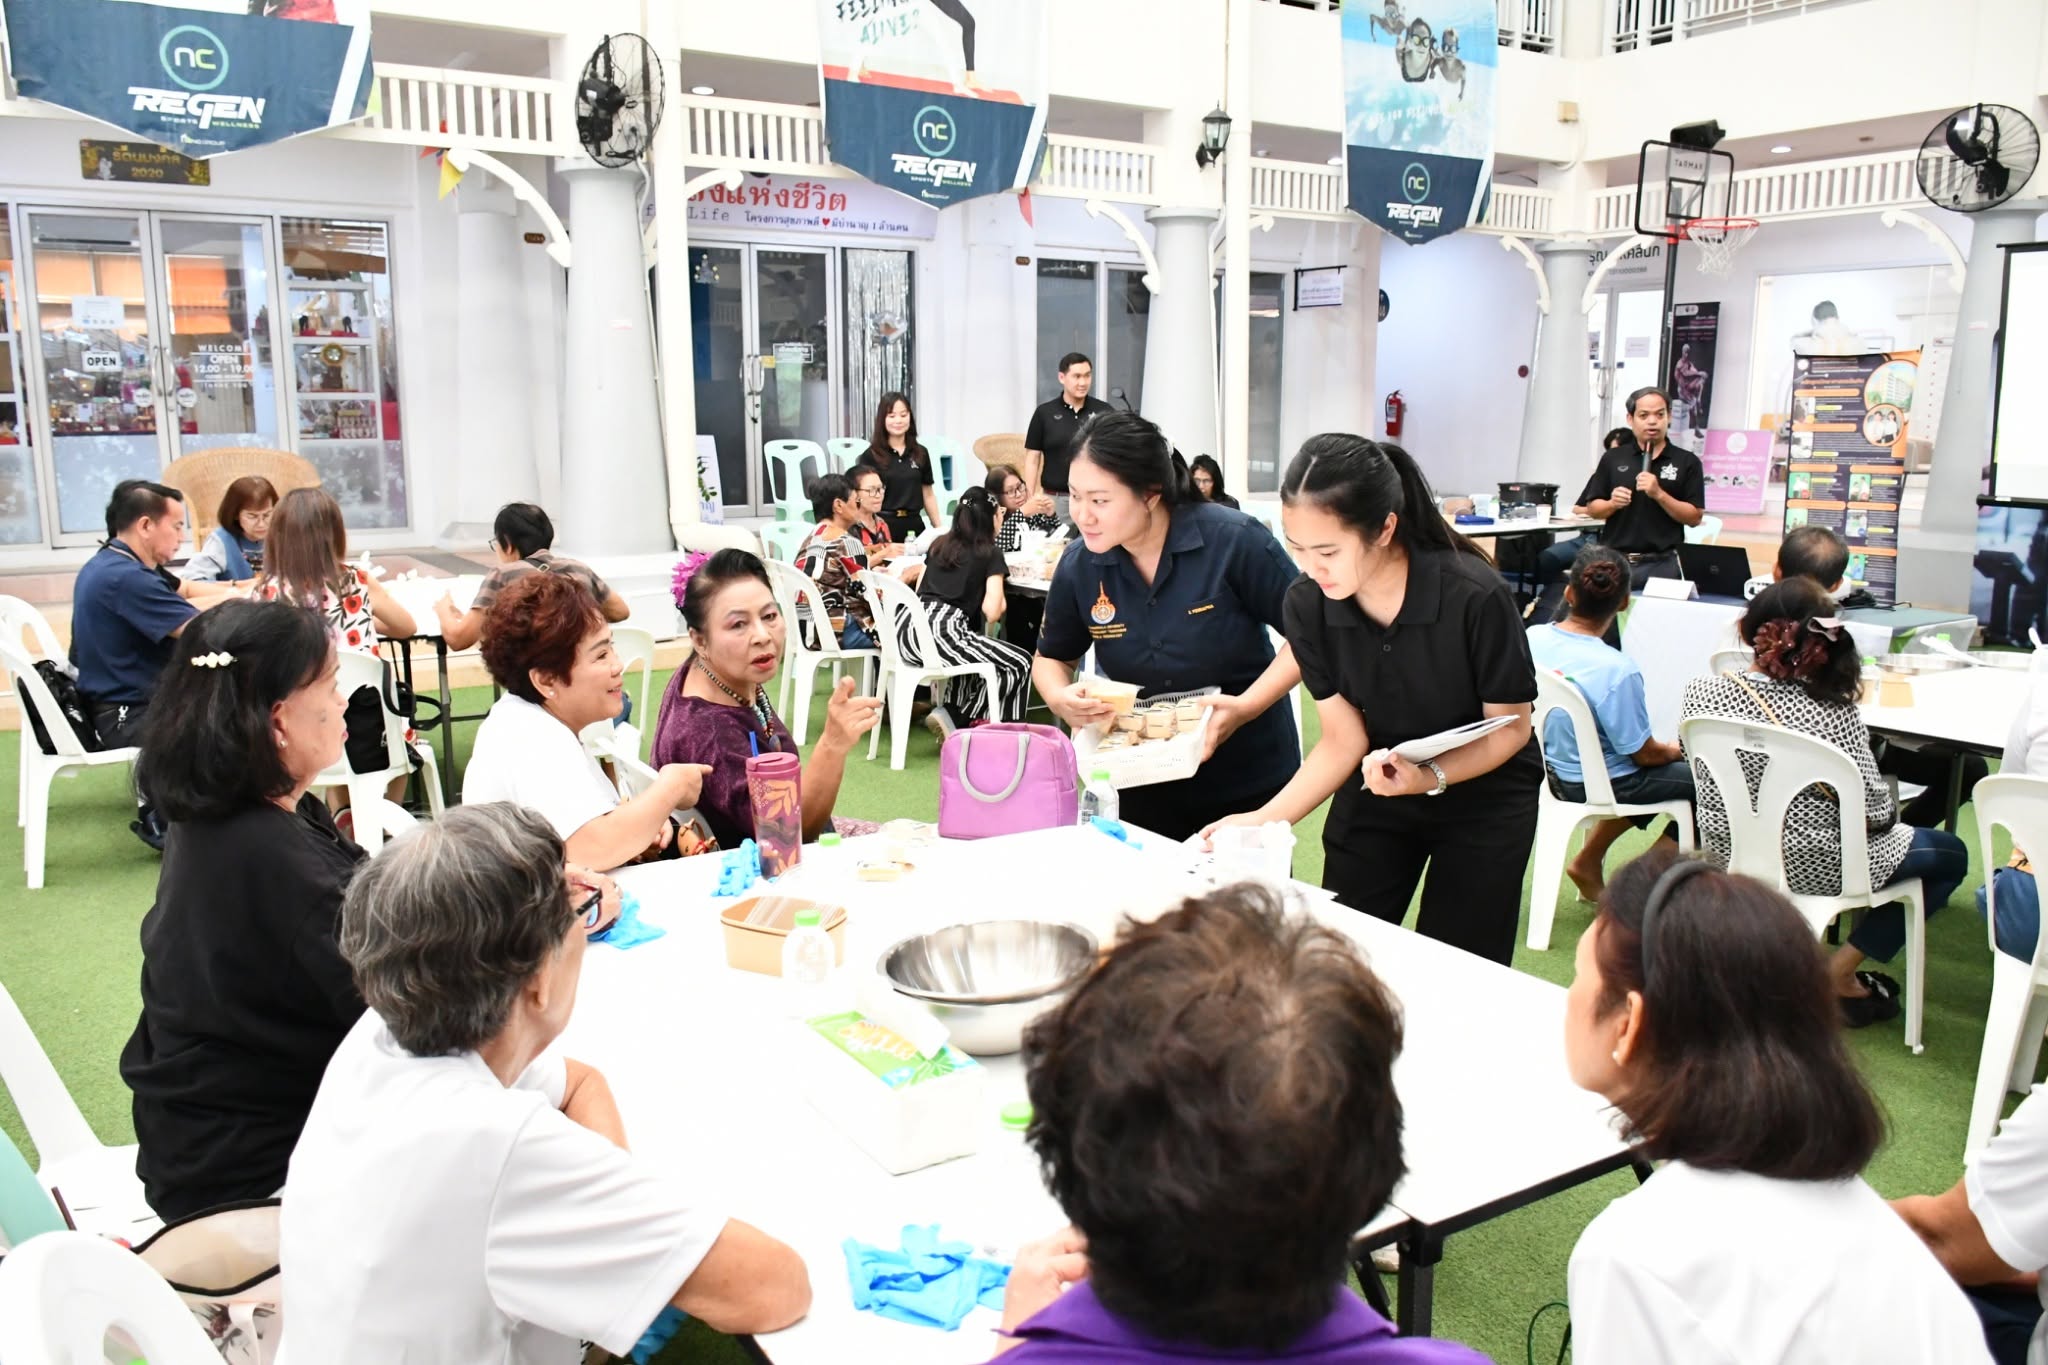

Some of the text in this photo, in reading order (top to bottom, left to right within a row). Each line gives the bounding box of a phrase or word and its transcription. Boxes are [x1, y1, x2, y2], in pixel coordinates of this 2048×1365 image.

[174, 47, 217, 69] nc
[127, 86, 266, 130] REGEN
[212, 120, 260, 129] WELLNESS
[922, 122, 949, 140] nc
[131, 167, 164, 178] 2020
[891, 153, 977, 187] REGEN
[1408, 176, 1425, 190] nc
[688, 206, 730, 221] Life
[1386, 203, 1443, 228] REGEN
[87, 357, 116, 366] OPEN
[210, 355, 239, 364] OPEN
[194, 365, 220, 373] 12.00
